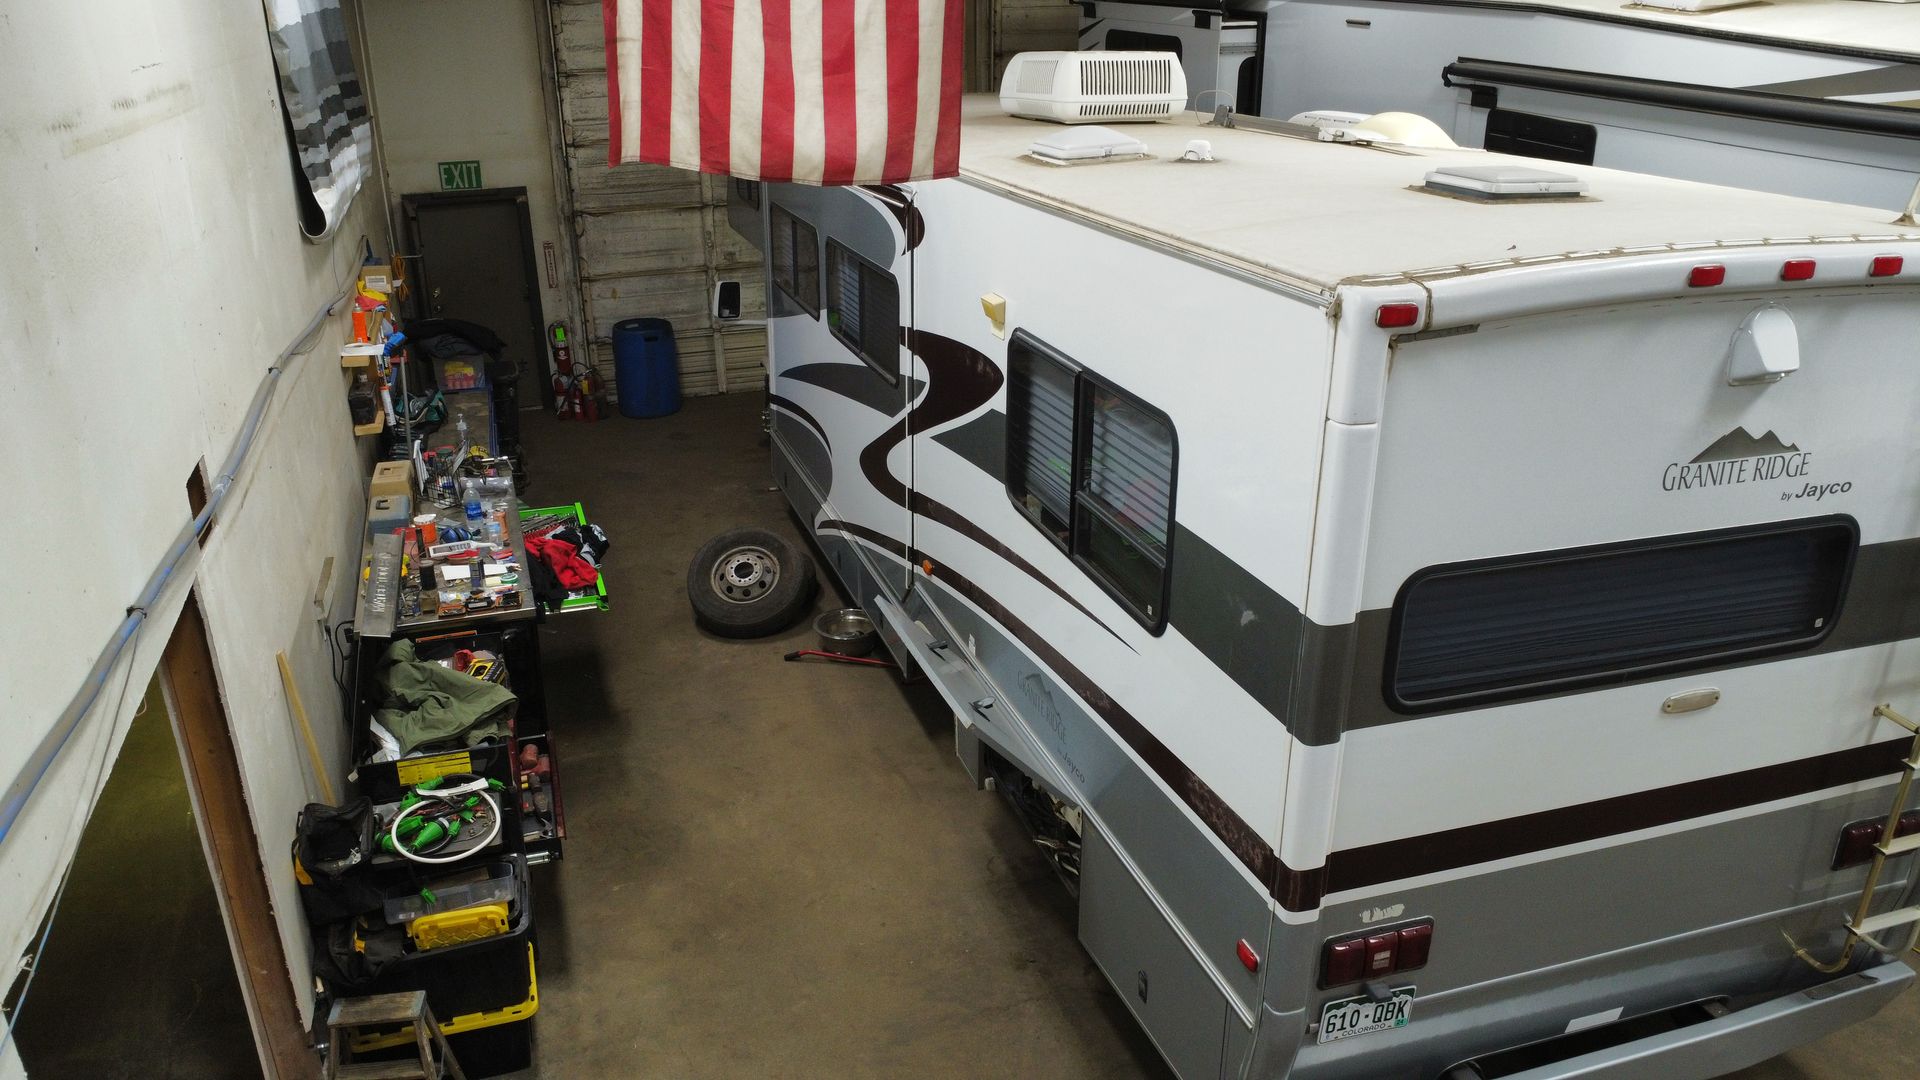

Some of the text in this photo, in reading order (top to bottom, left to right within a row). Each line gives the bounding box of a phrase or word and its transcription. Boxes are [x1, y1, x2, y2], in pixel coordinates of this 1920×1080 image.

[440, 163, 478, 189] EXIT
[1662, 452, 1812, 492] GRANITE RIDGE
[1781, 481, 1852, 501] by Jayco
[1341, 1023, 1386, 1036] COLORADO
